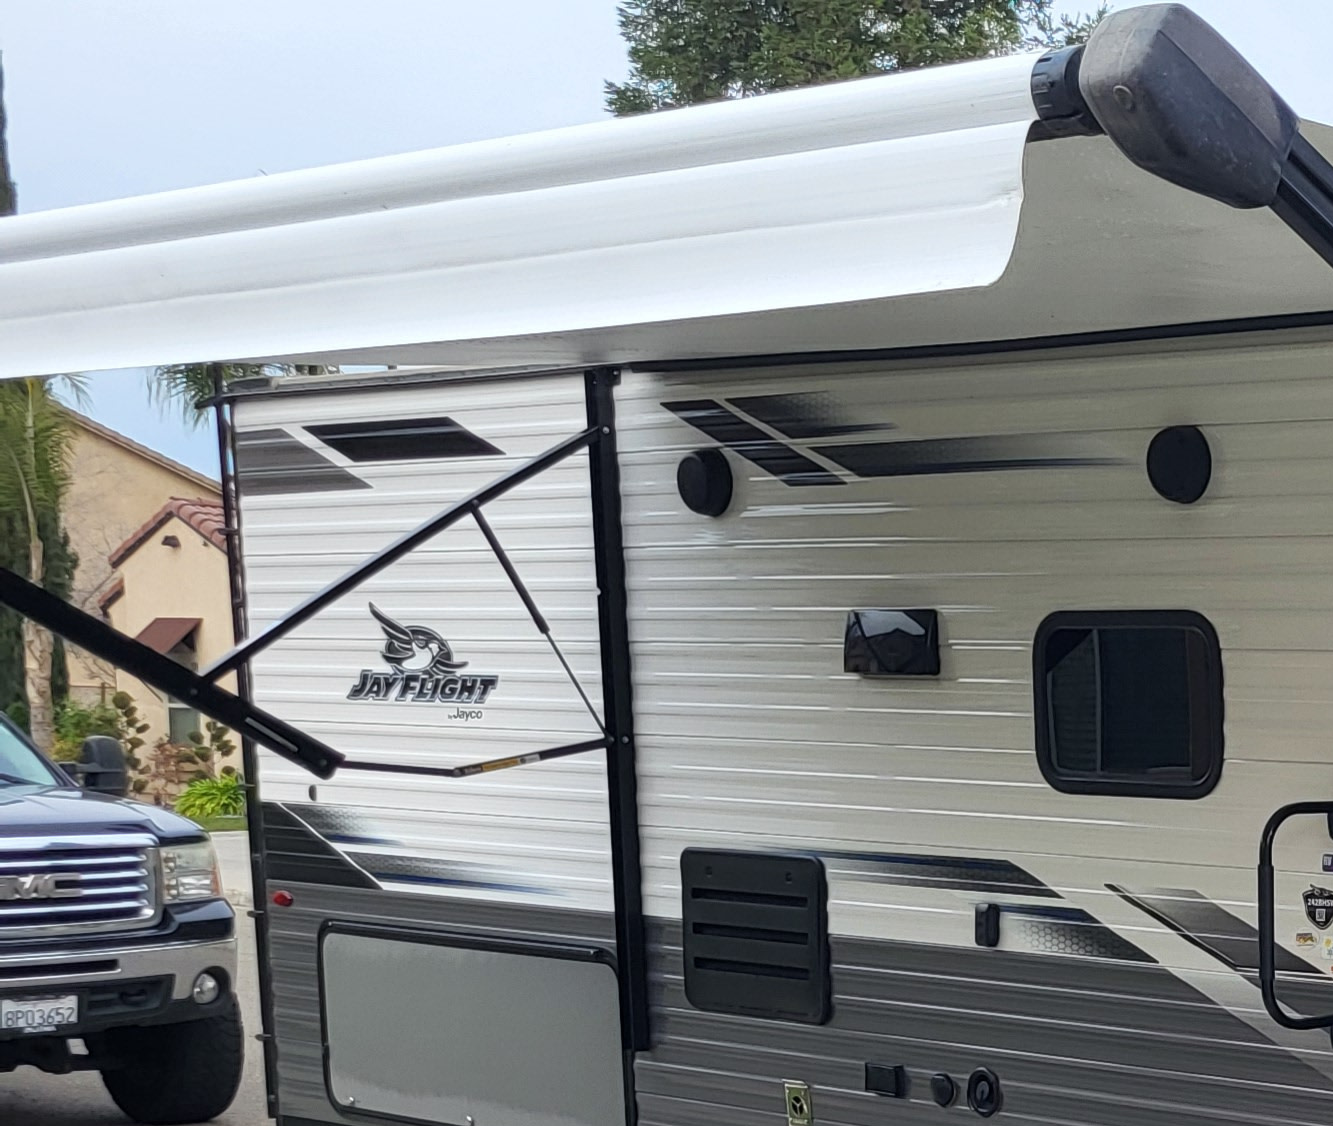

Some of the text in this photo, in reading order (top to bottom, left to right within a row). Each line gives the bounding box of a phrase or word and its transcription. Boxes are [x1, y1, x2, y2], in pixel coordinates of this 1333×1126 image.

[346, 669, 499, 704] JAY FLIGHT
[453, 707, 483, 721] Jayco
